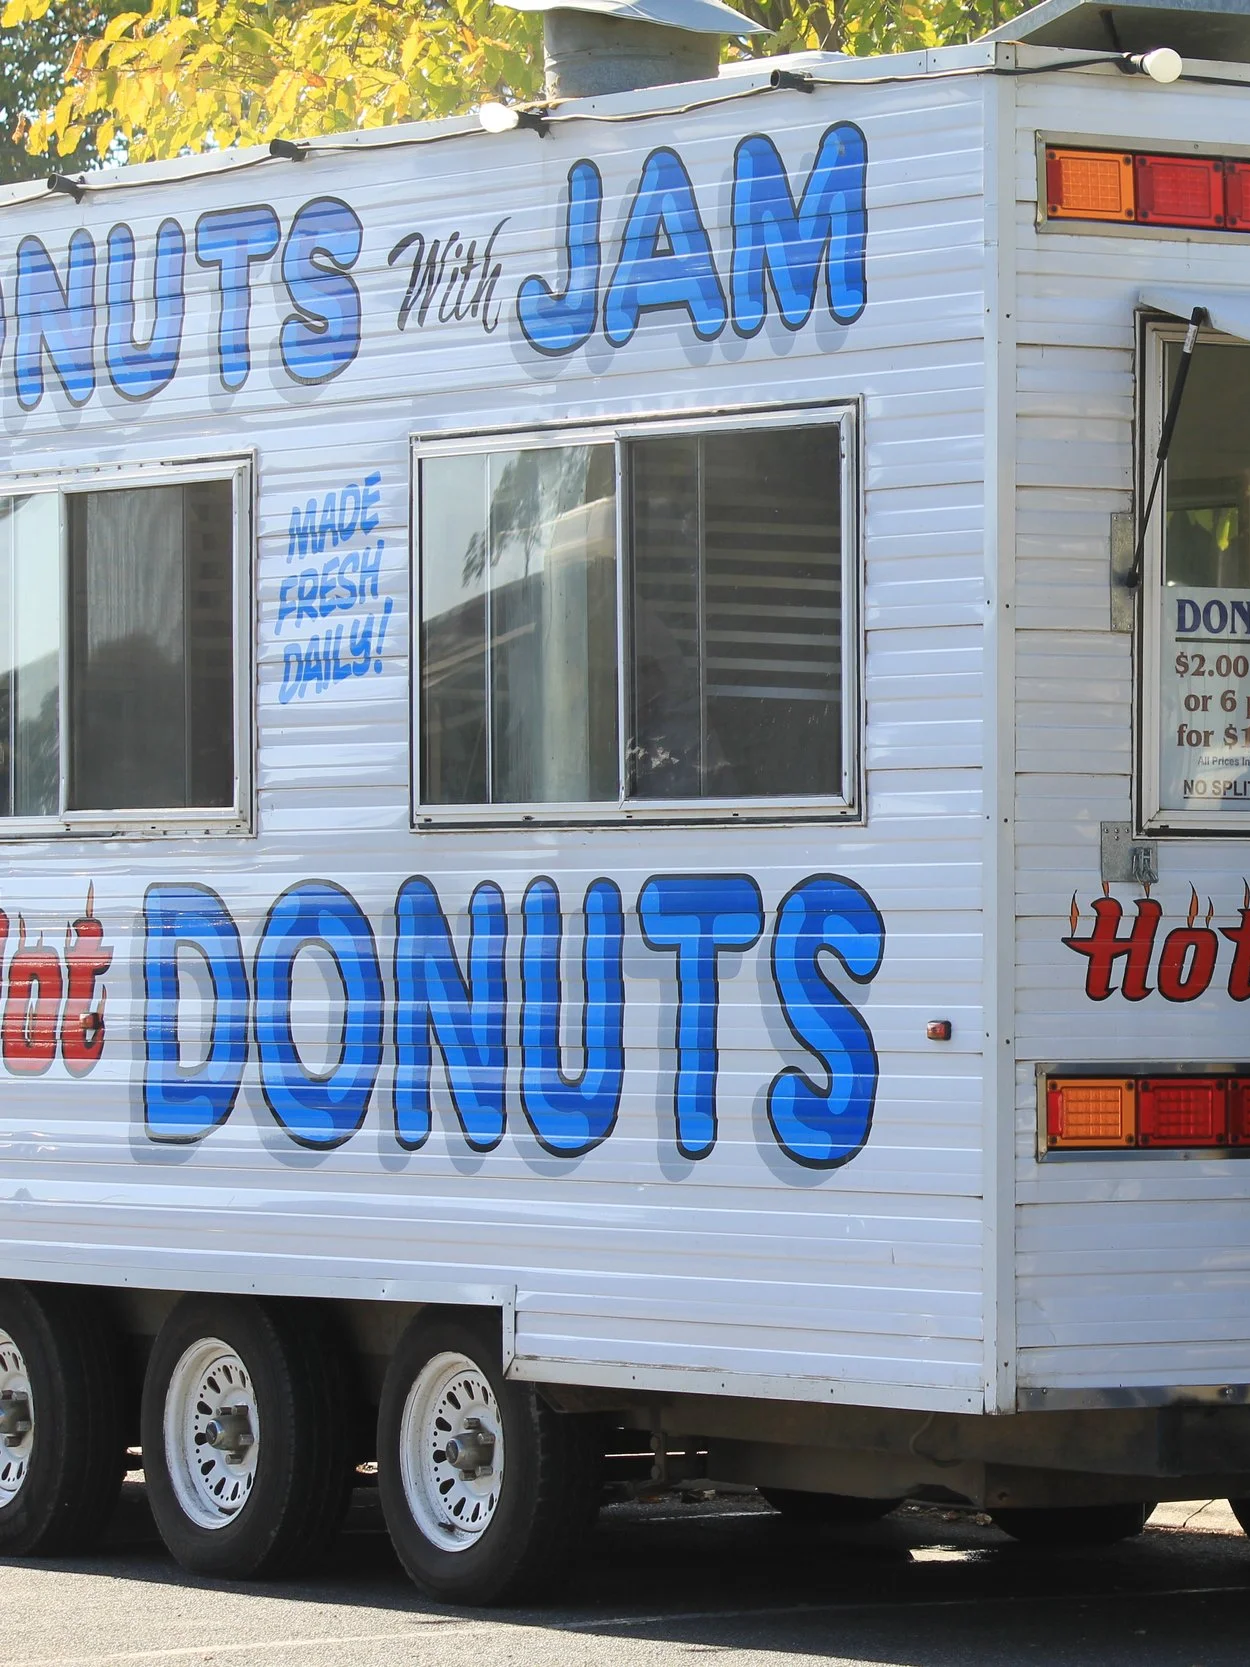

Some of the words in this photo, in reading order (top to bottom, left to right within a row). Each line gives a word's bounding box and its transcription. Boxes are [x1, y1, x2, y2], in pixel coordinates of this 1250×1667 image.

[0, 195, 364, 411] NUTS
[388, 216, 512, 333] With
[517, 120, 869, 356] JAM
[288, 470, 381, 561] MADE
[275, 540, 385, 635] FRESH
[278, 599, 393, 704] DAILY!
[1174, 651, 1249, 678] $2.00
[1184, 693, 1212, 712] or
[1220, 689, 1237, 713] 6
[1176, 724, 1214, 748] for
[1197, 756, 1210, 766] All
[1212, 756, 1239, 767] Prices
[1183, 779, 1207, 796] NO
[0, 880, 114, 1078] ot
[142, 872, 887, 1170] DONUTS
